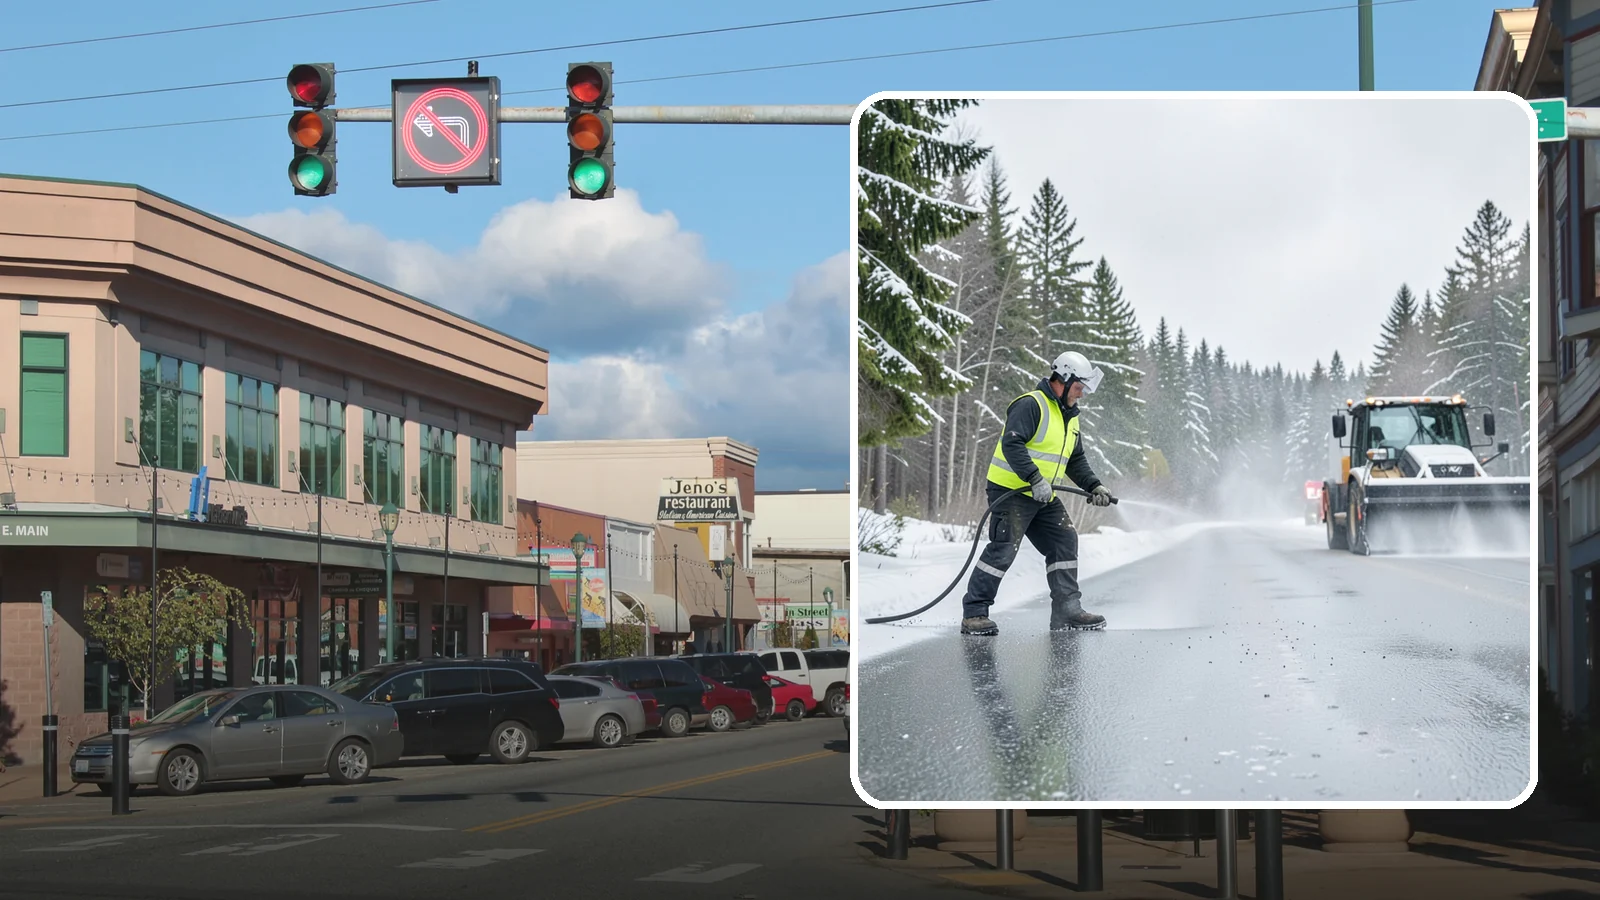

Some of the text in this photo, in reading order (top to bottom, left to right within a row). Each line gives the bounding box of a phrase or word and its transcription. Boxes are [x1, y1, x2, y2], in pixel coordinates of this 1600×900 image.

[669, 480, 727, 495] Jeno's
[665, 496, 731, 509] restaurant
[658, 510, 681, 520] Italian
[686, 509, 715, 519] American
[715, 509, 738, 519] Cuisine
[2, 525, 49, 536] E. MAIN
[797, 607, 829, 617] Street
